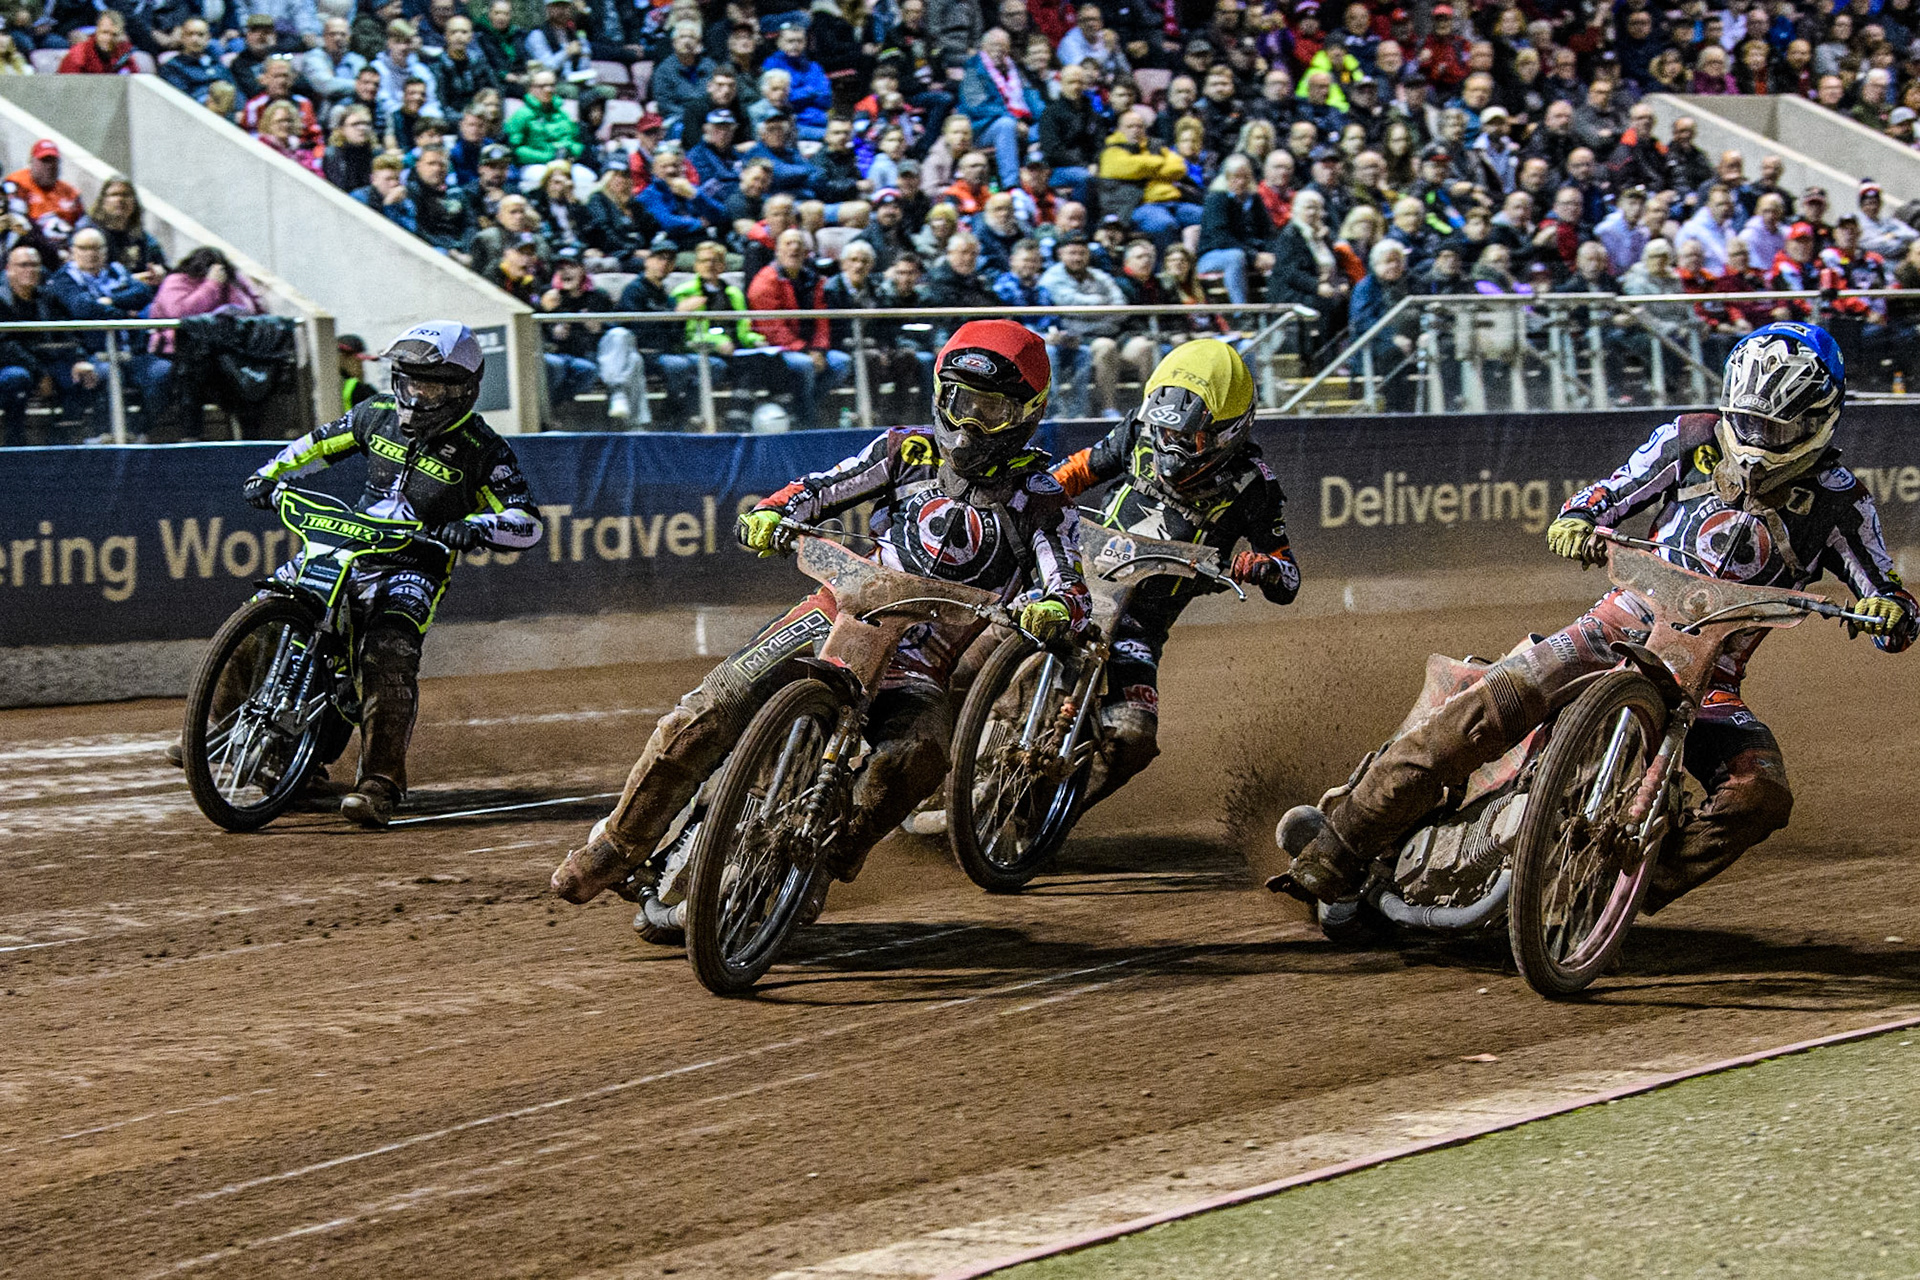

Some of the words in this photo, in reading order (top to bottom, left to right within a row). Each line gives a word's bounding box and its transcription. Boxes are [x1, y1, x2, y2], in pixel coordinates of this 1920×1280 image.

[914, 489, 944, 507] BELL
[1319, 469, 1550, 534] Delivering
[1699, 500, 1729, 520] BELL
[0, 520, 137, 601] ring
[539, 495, 717, 563] Travel
